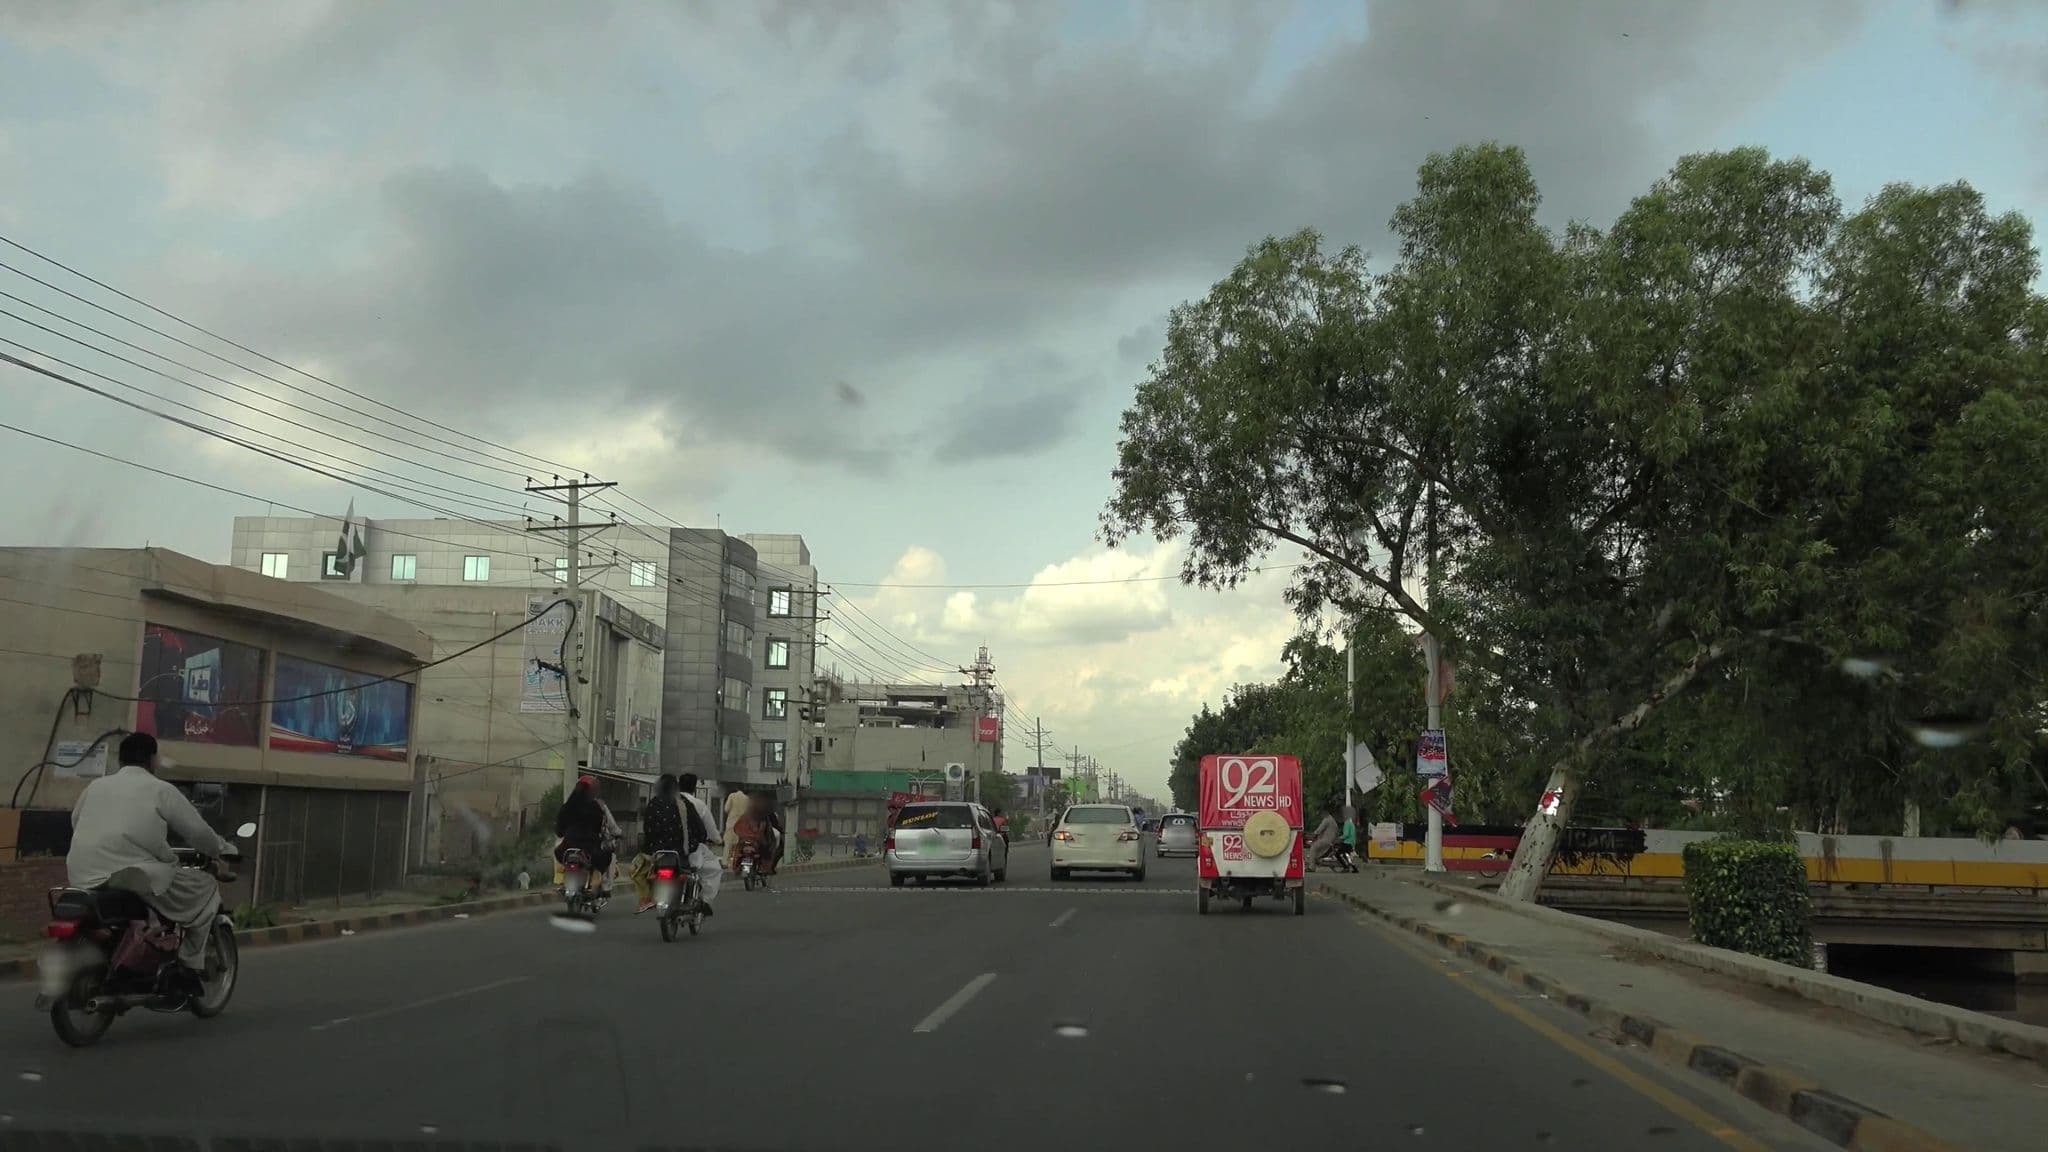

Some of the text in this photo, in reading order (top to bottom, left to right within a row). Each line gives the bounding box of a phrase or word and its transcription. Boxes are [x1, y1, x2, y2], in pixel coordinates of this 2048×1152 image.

[1221, 758, 1275, 809] 92
[1243, 795, 1292, 808] NEWS HD
[902, 811, 939, 825] DUNLOP
[1223, 835, 1242, 852] 92
